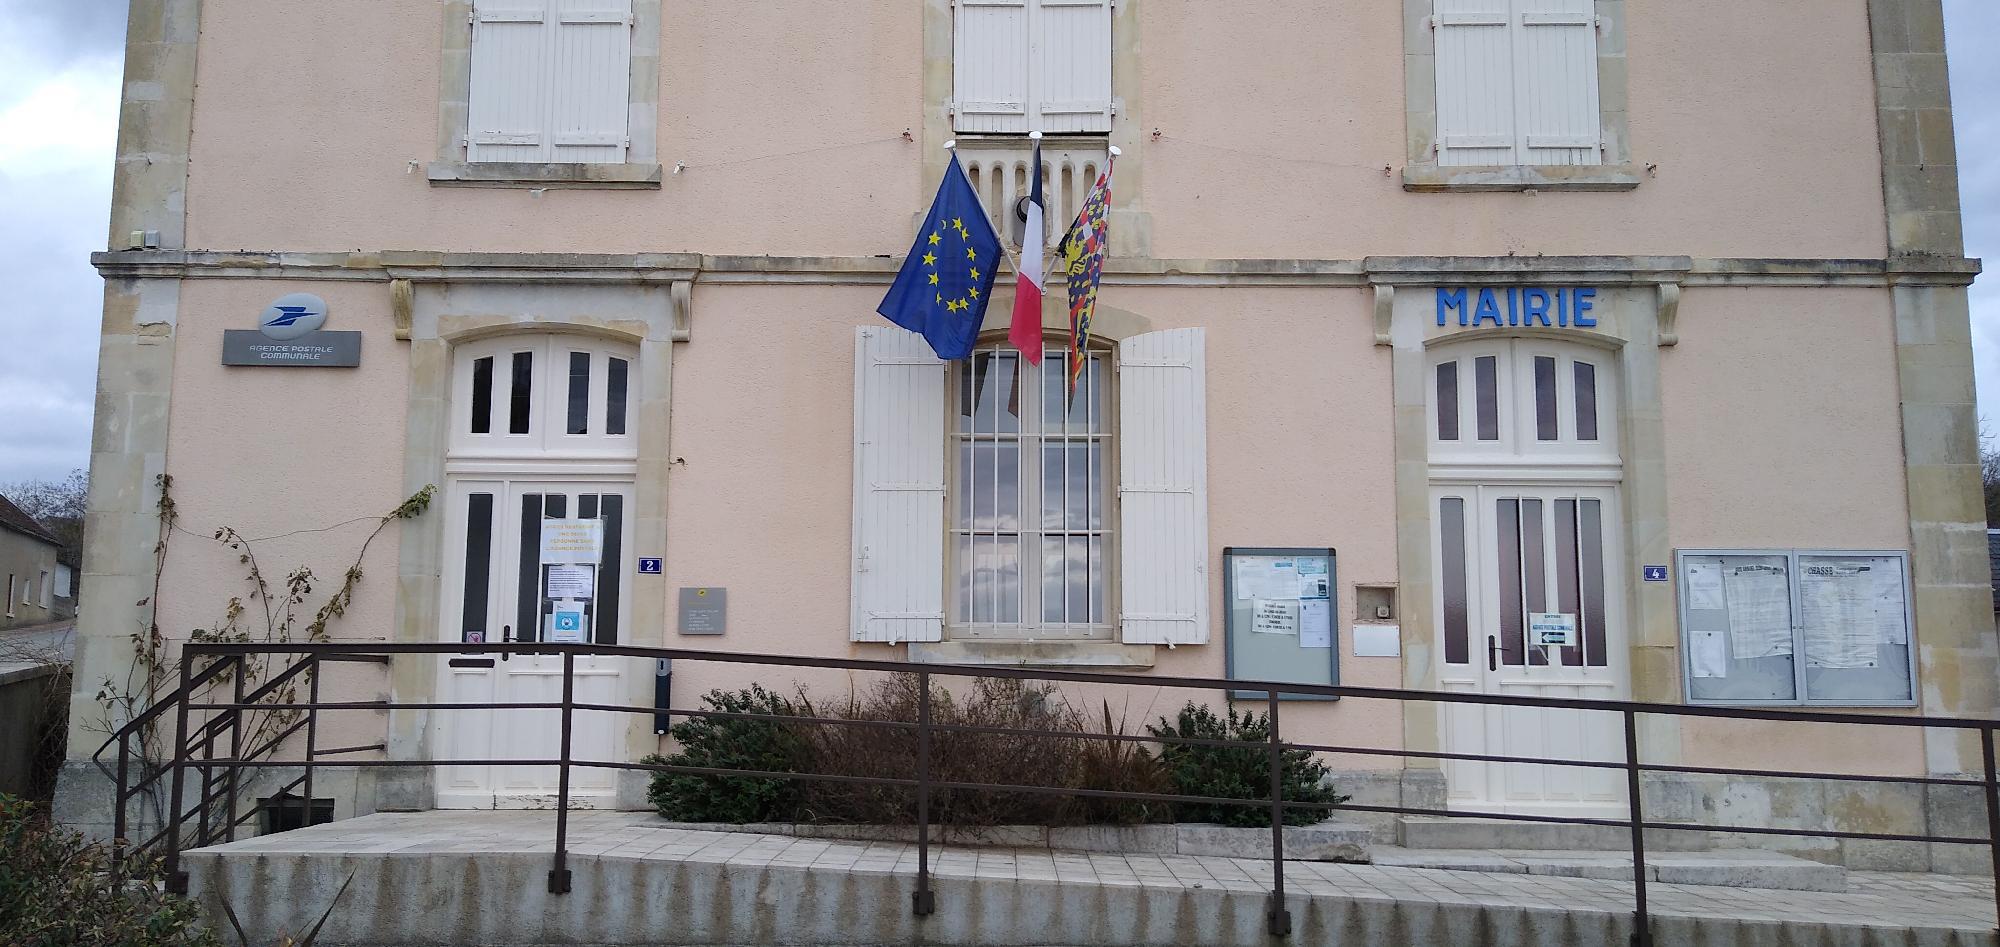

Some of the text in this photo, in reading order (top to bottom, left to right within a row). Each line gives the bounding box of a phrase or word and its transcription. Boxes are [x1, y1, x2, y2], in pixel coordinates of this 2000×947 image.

[1437, 287, 1597, 326] MAIRIE
[292, 345, 333, 353] POSTALE
[260, 352, 321, 360] COMMUNALE
[646, 560, 654, 571] 2
[1807, 566, 1834, 575] CHASSE
[1652, 568, 1660, 579] 4
